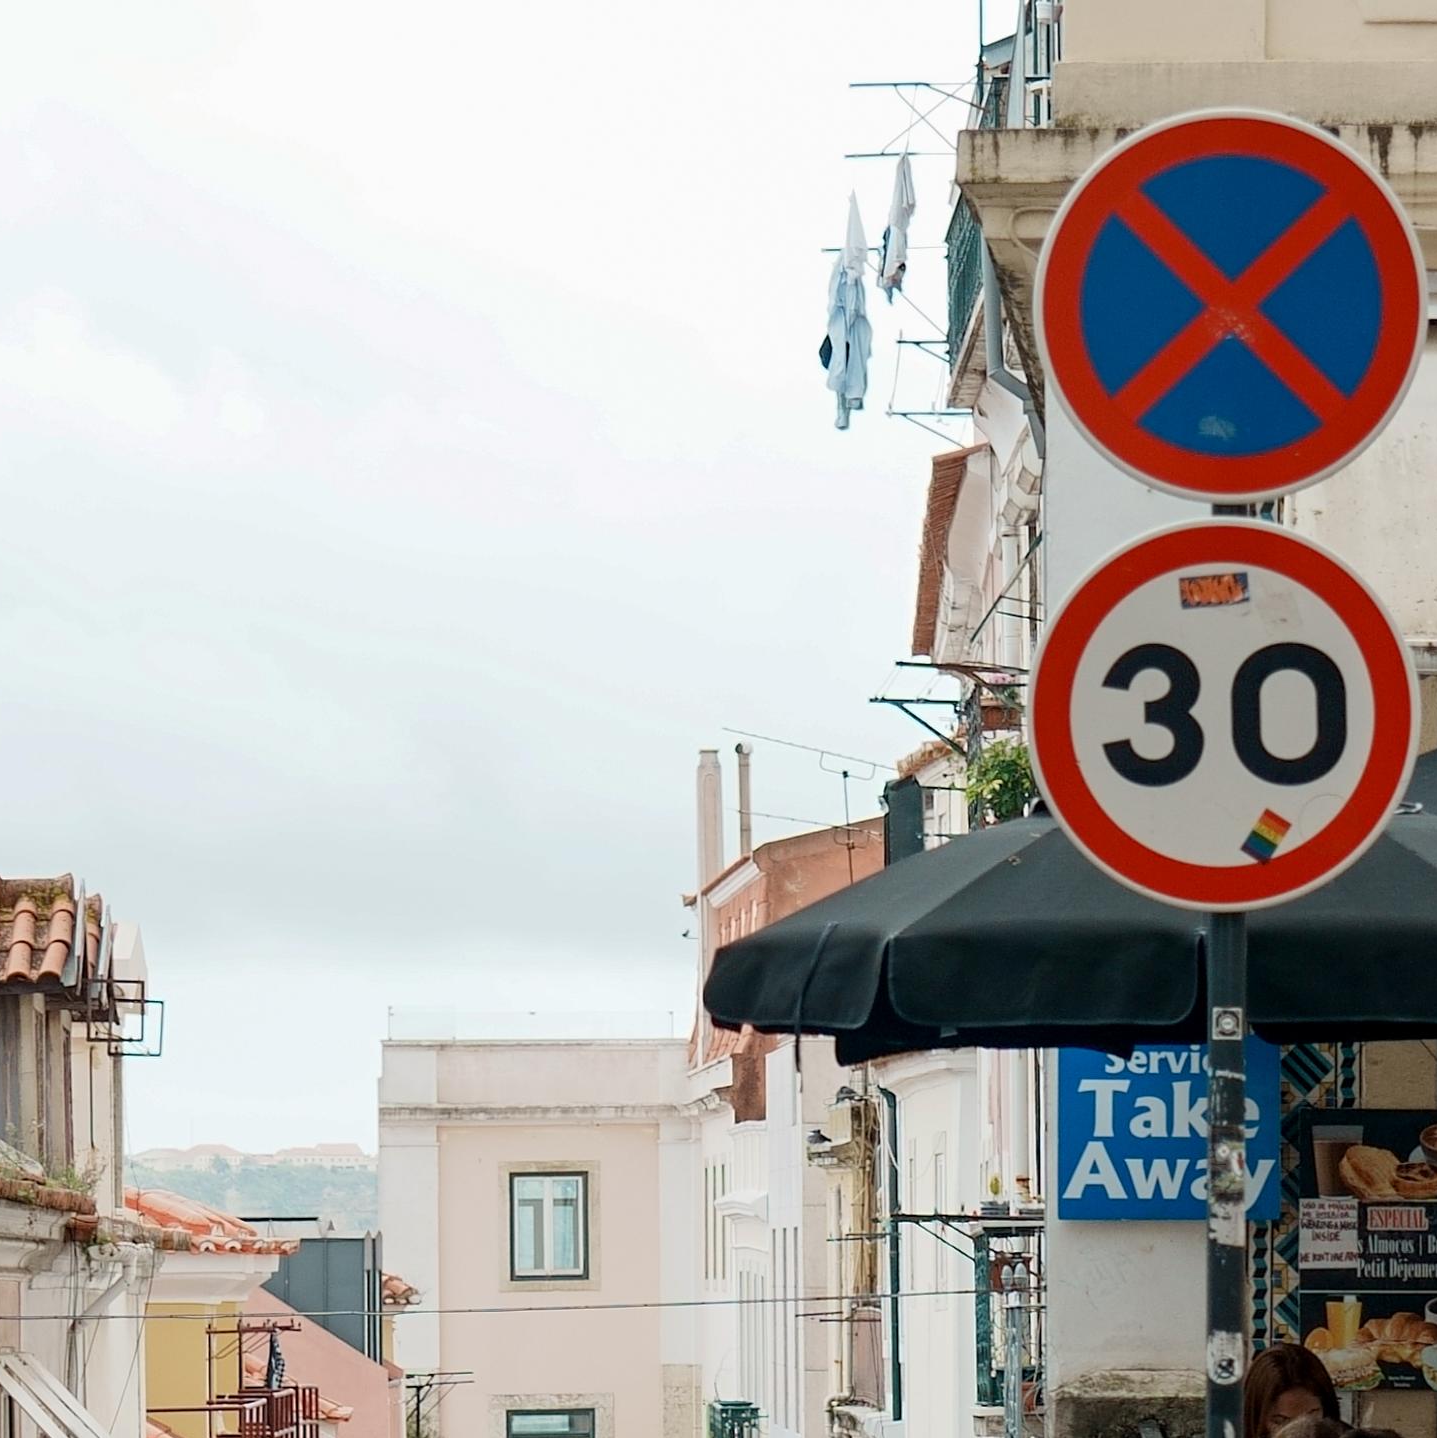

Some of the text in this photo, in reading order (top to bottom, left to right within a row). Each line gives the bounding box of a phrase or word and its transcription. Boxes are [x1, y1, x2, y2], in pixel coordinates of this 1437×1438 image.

[1101, 641, 1348, 787] 30
[1370, 1209, 1426, 1229] ESPECIAL
[1312, 1230, 1341, 1241] INSIDE
[1368, 1234, 1414, 1259] Almoços
[1356, 1258, 1386, 1278] Petit
